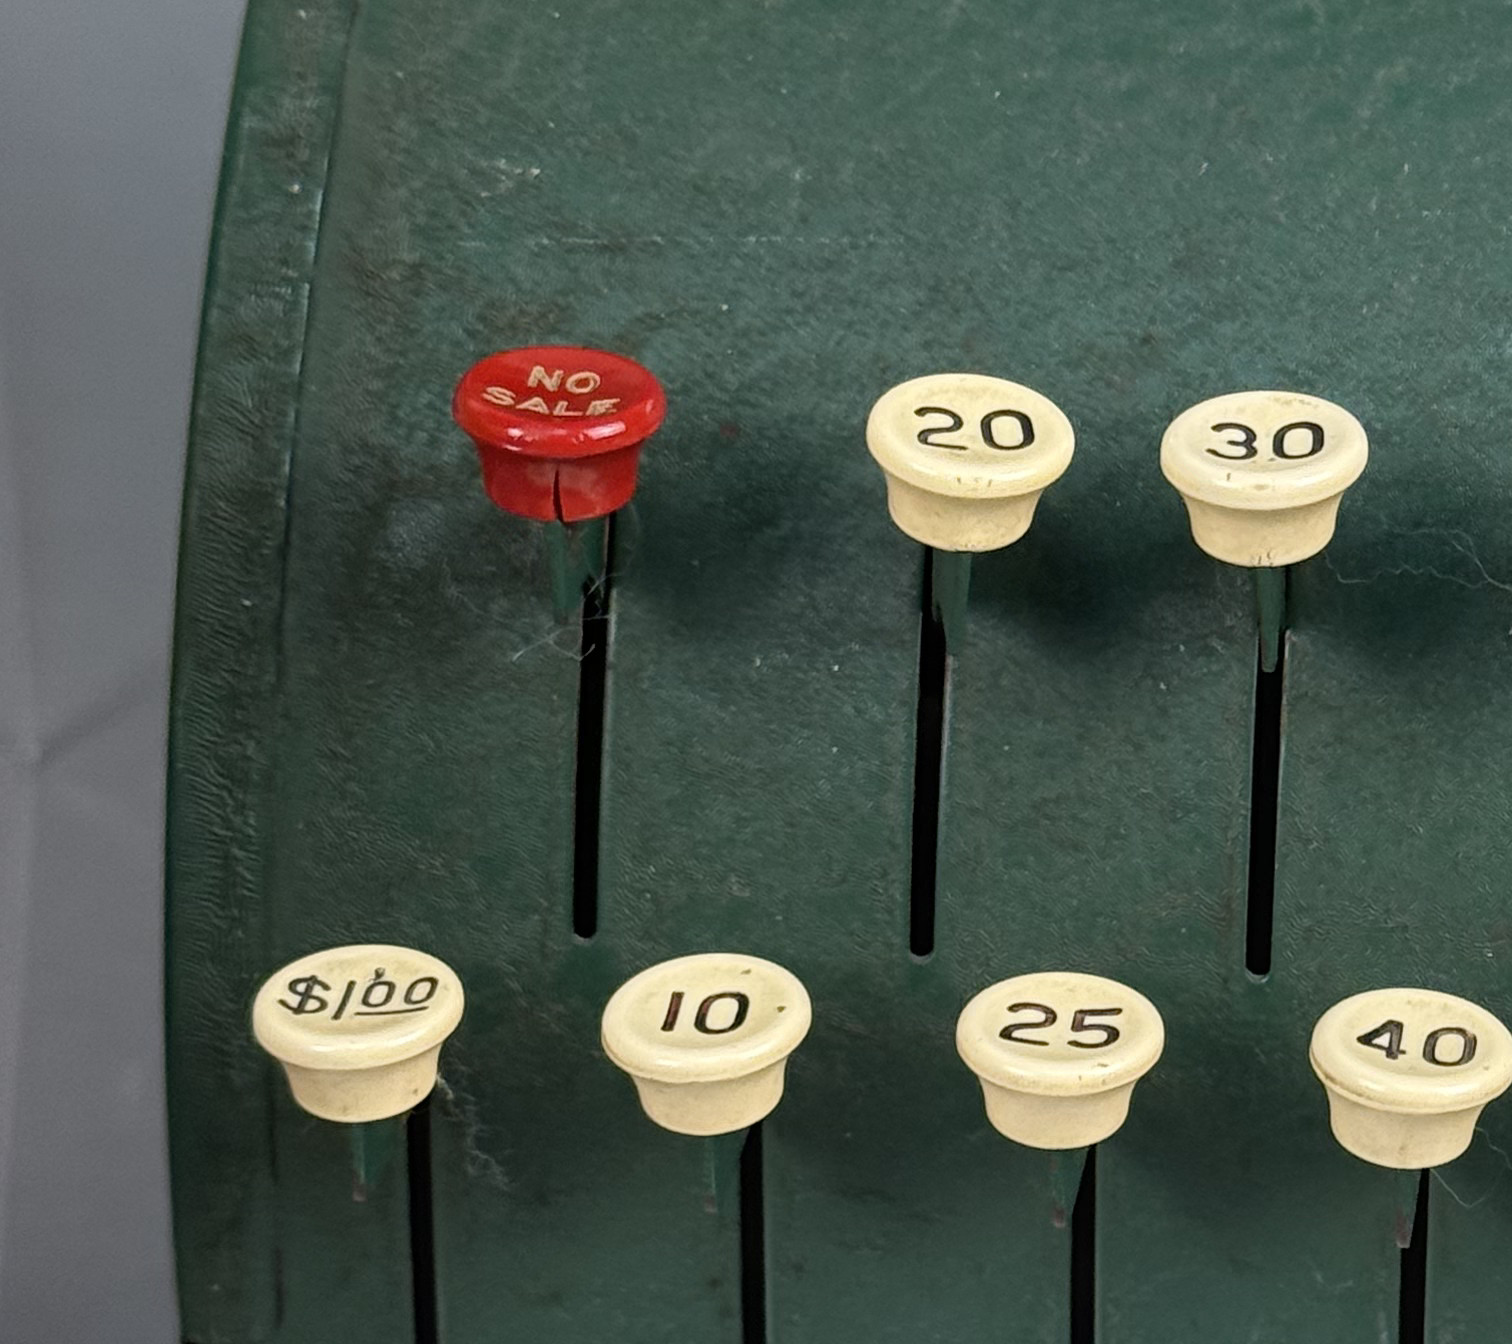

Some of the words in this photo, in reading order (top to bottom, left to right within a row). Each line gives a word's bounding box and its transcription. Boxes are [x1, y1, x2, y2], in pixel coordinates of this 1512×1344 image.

[480, 385, 622, 418] SALE
[527, 364, 602, 395] NO
[913, 406, 1036, 452] 20
[1205, 421, 1325, 461] 30
[659, 991, 749, 1036] 10
[998, 1001, 1125, 1049] 25
[1355, 1018, 1478, 1067] 40
